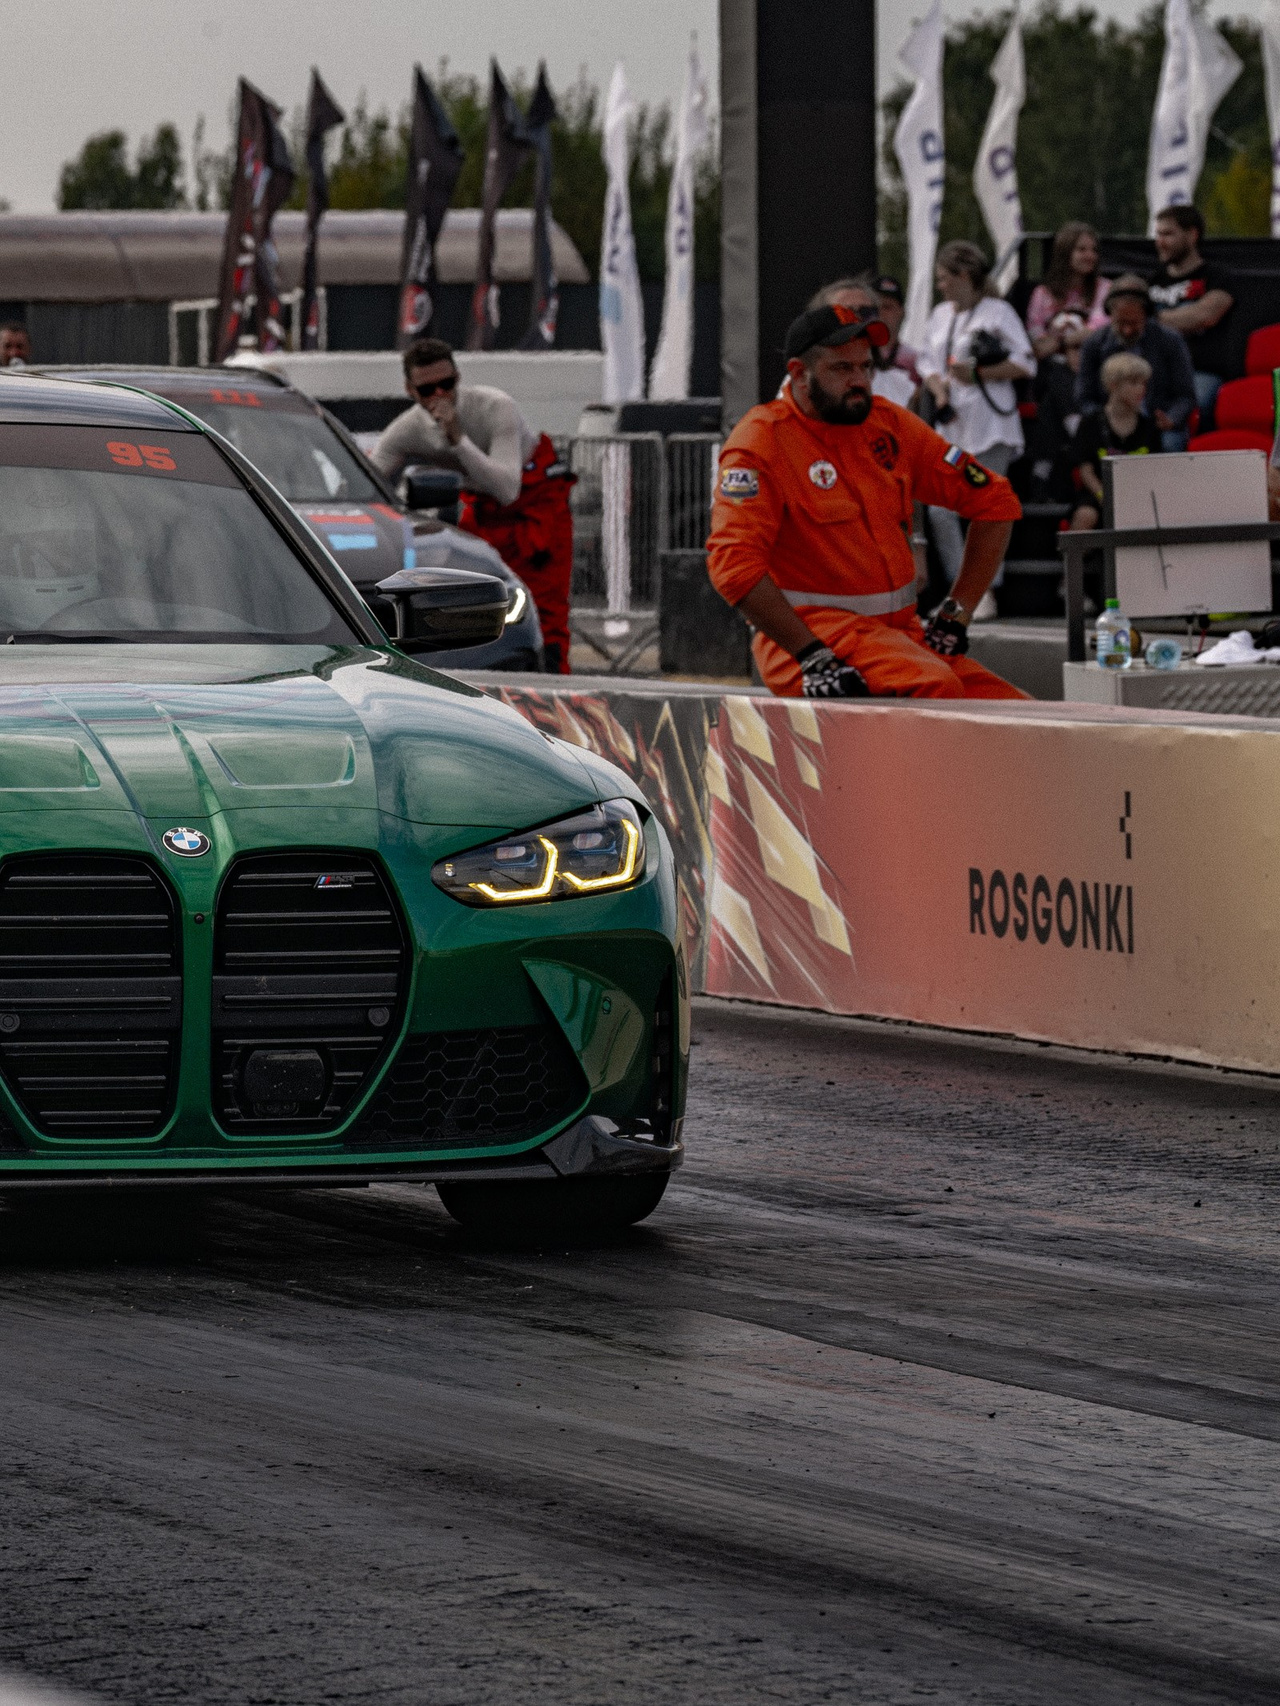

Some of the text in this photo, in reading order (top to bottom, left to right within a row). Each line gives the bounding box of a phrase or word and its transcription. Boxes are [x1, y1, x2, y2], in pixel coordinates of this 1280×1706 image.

[106, 441, 177, 472] 95
[728, 473, 749, 483] FIA
[968, 867, 1135, 955] ROSGONKI
